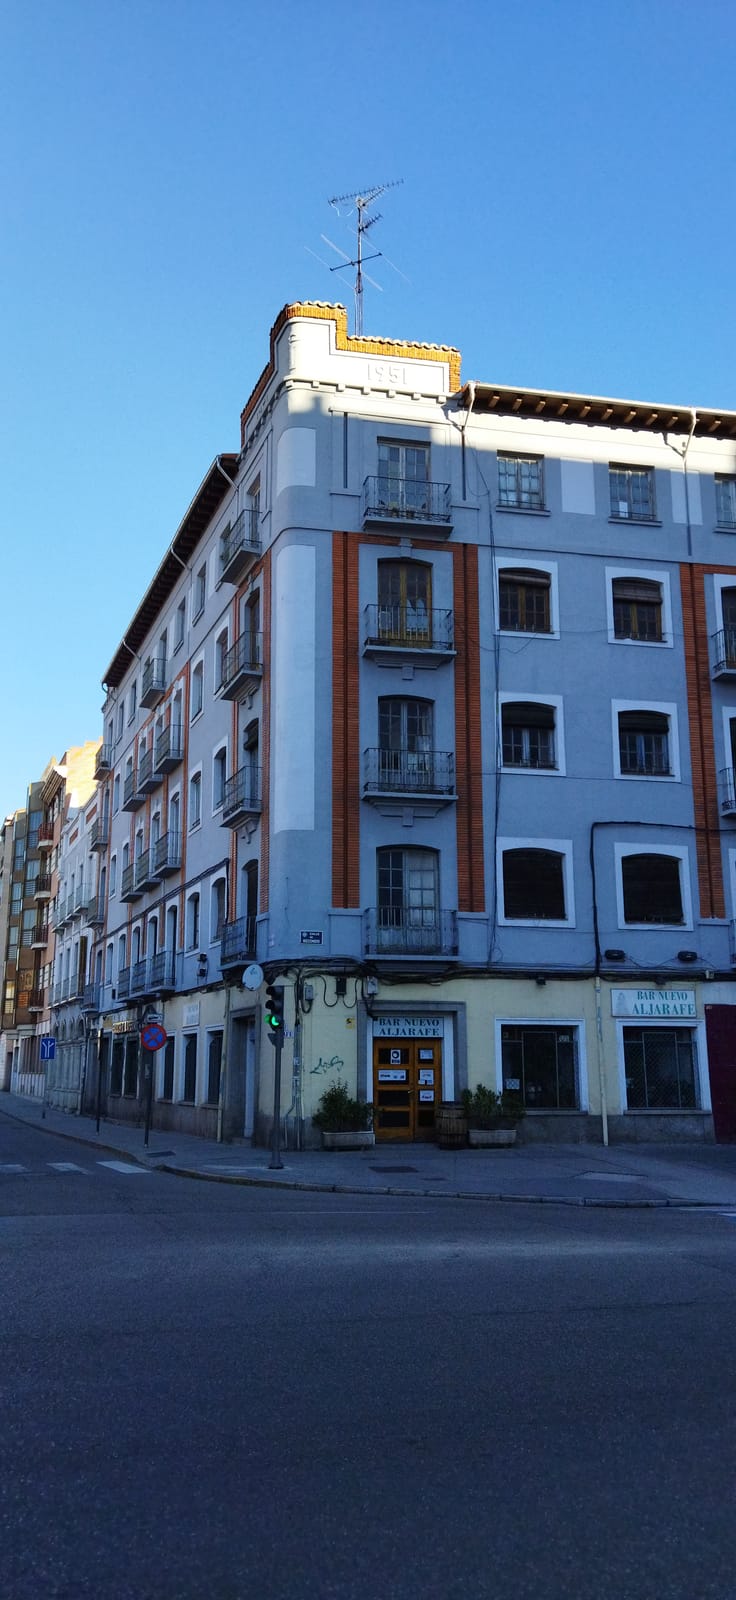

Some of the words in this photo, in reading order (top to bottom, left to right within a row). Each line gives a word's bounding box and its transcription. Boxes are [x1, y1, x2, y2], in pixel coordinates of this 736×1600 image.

[367, 363, 407, 385] 1951
[637, 991, 655, 1001] BAR
[659, 991, 688, 1001] NUEVO
[632, 1003, 695, 1015] ALJARAFE
[379, 1018, 400, 1026] BAR
[405, 1018, 440, 1027] NUEVO
[379, 1028, 440, 1036] ALJARAFE
